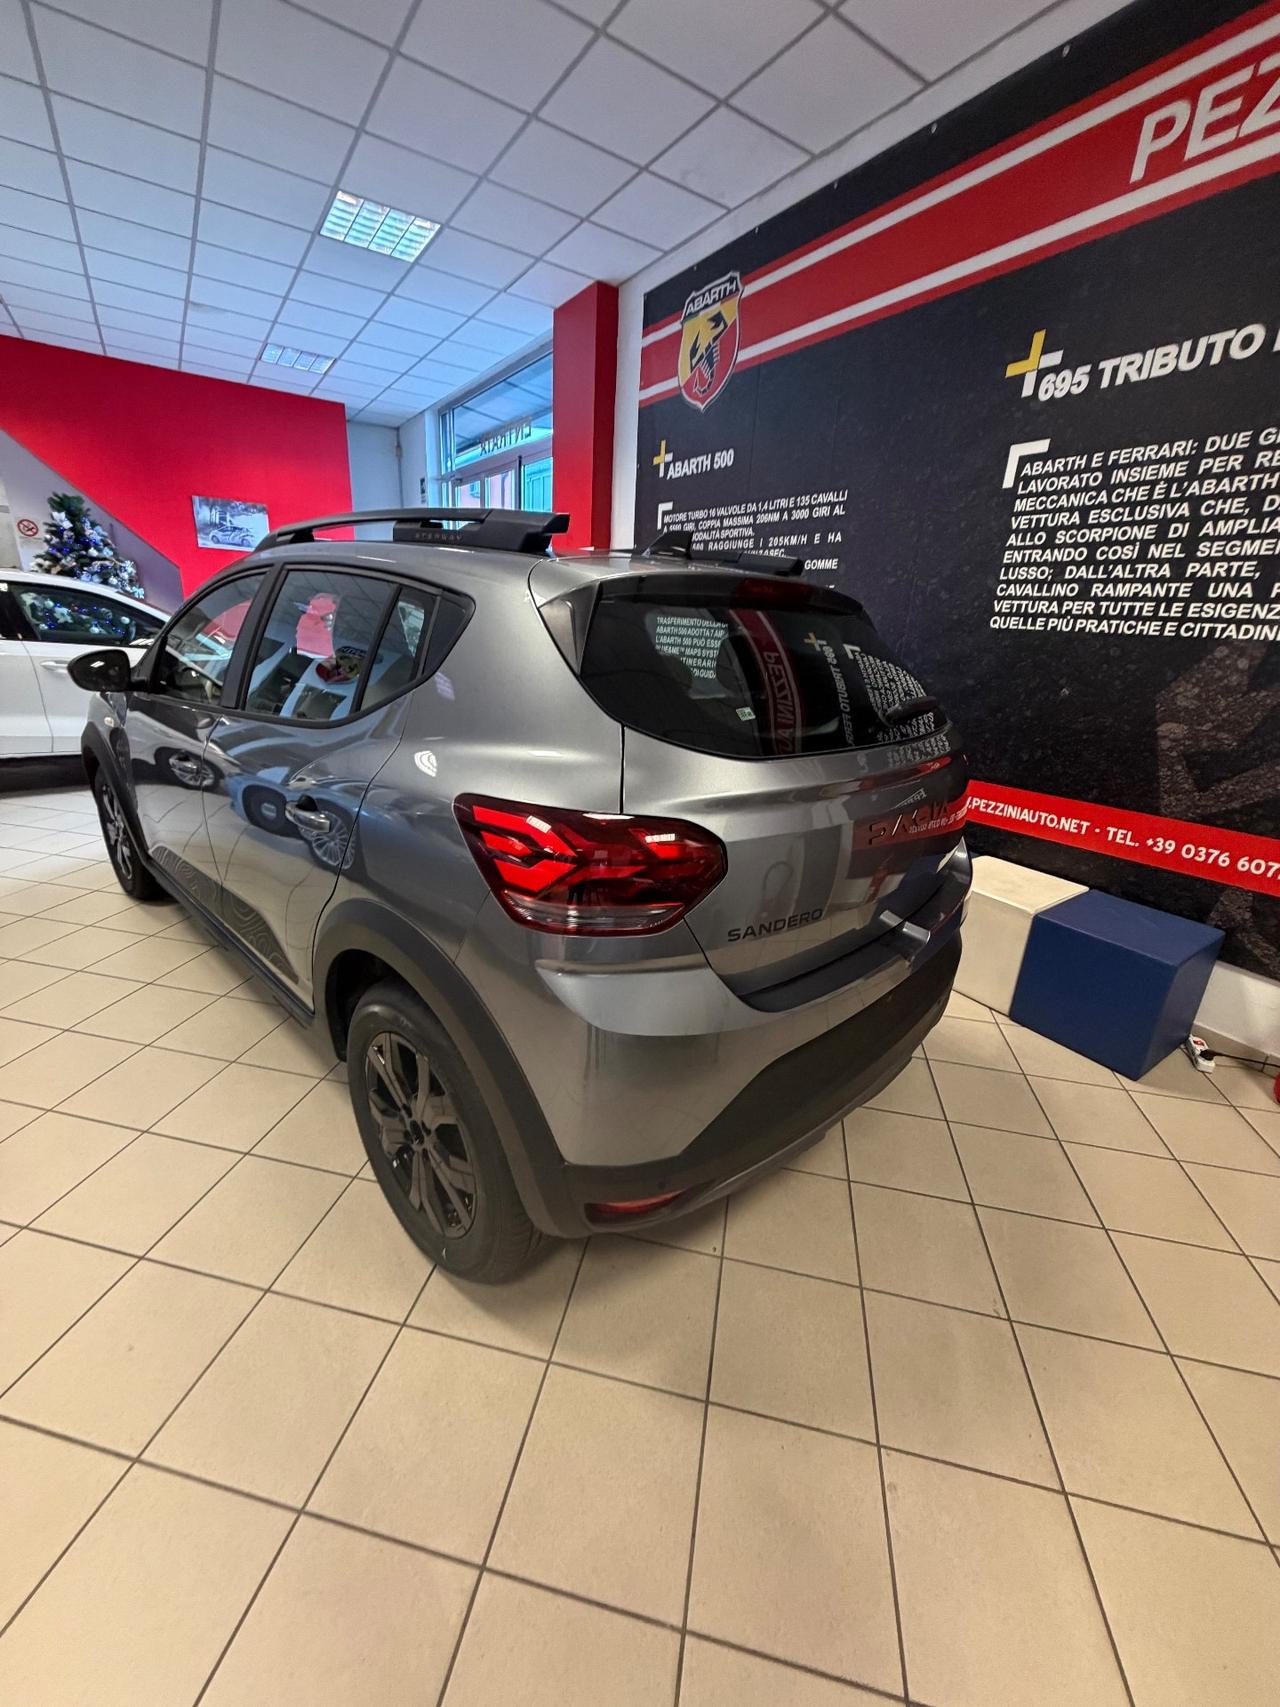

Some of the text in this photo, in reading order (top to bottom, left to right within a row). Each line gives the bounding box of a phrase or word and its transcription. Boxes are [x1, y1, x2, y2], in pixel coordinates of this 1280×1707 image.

[686, 279, 737, 316] ABARTH
[1038, 363, 1092, 401] 695
[1098, 323, 1266, 389] TRIBUTO
[667, 448, 734, 480] ABARTH 500
[1020, 427, 1280, 477] ABARTH E FERRARI: DUE G
[1017, 472, 1103, 495] LAVORATO
[1110, 460, 1190, 485] INSIEME
[1198, 454, 1244, 475] PER
[663, 511, 687, 524] MOTORE
[688, 508, 708, 520] TURBO
[709, 507, 717, 518] 16
[717, 503, 746, 517] VALVOLE
[747, 502, 757, 513] DA
[769, 498, 788, 511] LITRI
[789, 497, 795, 508] E
[796, 495, 810, 507] 135
[811, 489, 848, 505] CAVALLI
[1013, 489, 1108, 513] MECCANICA
[1111, 484, 1151, 503] CHE
[698, 518, 721, 530] COPPIA
[722, 515, 754, 528] MASSIMA
[782, 511, 788, 521] A
[791, 508, 809, 520] 3000
[812, 506, 831, 518] GIRI
[833, 504, 846, 516] AL
[1011, 494, 1280, 530] VETTURA ESCLUSIVA CHE, D
[708, 538, 754, 551] RAGGIUNGE
[760, 538, 763, 548] I
[768, 534, 807, 547] 205KM/H
[814, 533, 820, 544] E
[828, 531, 842, 543] HA
[720, 527, 755, 539] SPORTIVA.
[1005, 531, 1046, 547] ALLO
[1055, 524, 1158, 544] SCORPIONE
[1168, 522, 1190, 539] DI
[804, 558, 838, 570] GOMME
[1003, 547, 1088, 563] ENTRANDO
[1095, 541, 1140, 560] COSÌ
[1147, 542, 1186, 559] NEL
[999, 560, 1261, 581] LUSSO; DALL'ALTRA PARTE,
[996, 583, 1079, 597] CAVALLINO
[1090, 582, 1194, 598] RAMPANTE
[1207, 582, 1253, 598] UNA
[993, 600, 1059, 614] VETTURA
[1061, 601, 1096, 615] PER
[1099, 601, 1156, 616] TUTTE
[1158, 602, 1185, 617] LE
[656, 626, 678, 635] ABARTH
[990, 616, 1046, 631] QUELLE
[1047, 615, 1074, 632] PIÙ
[1074, 619, 1162, 635] PRATICHE
[1163, 621, 1179, 637] E
[1106, 826, 1140, 847] TEL.
[1146, 837, 1176, 854] +39
[1181, 844, 1230, 867] 0376
[1236, 856, 1280, 880] 607
[727, 908, 824, 942] SANDERO
